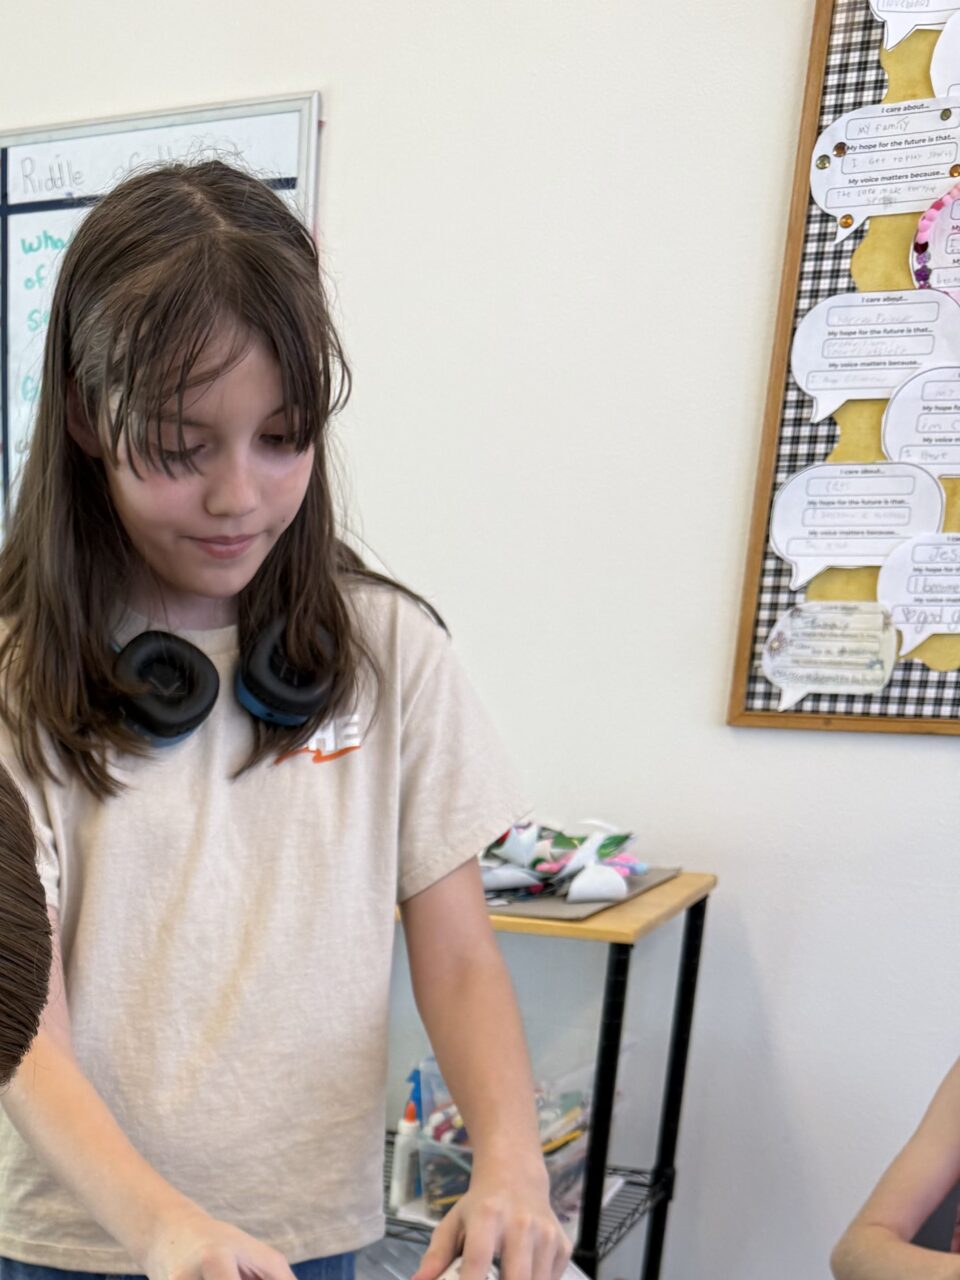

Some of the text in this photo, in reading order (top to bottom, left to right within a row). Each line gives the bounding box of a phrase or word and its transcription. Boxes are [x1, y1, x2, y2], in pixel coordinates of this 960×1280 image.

[858, 142, 877, 150] hope
[904, 137, 925, 146] future
[20, 154, 85, 195] Riddle
[848, 177, 859, 185] My
[860, 175, 879, 183] voice
[881, 173, 909, 182] matters
